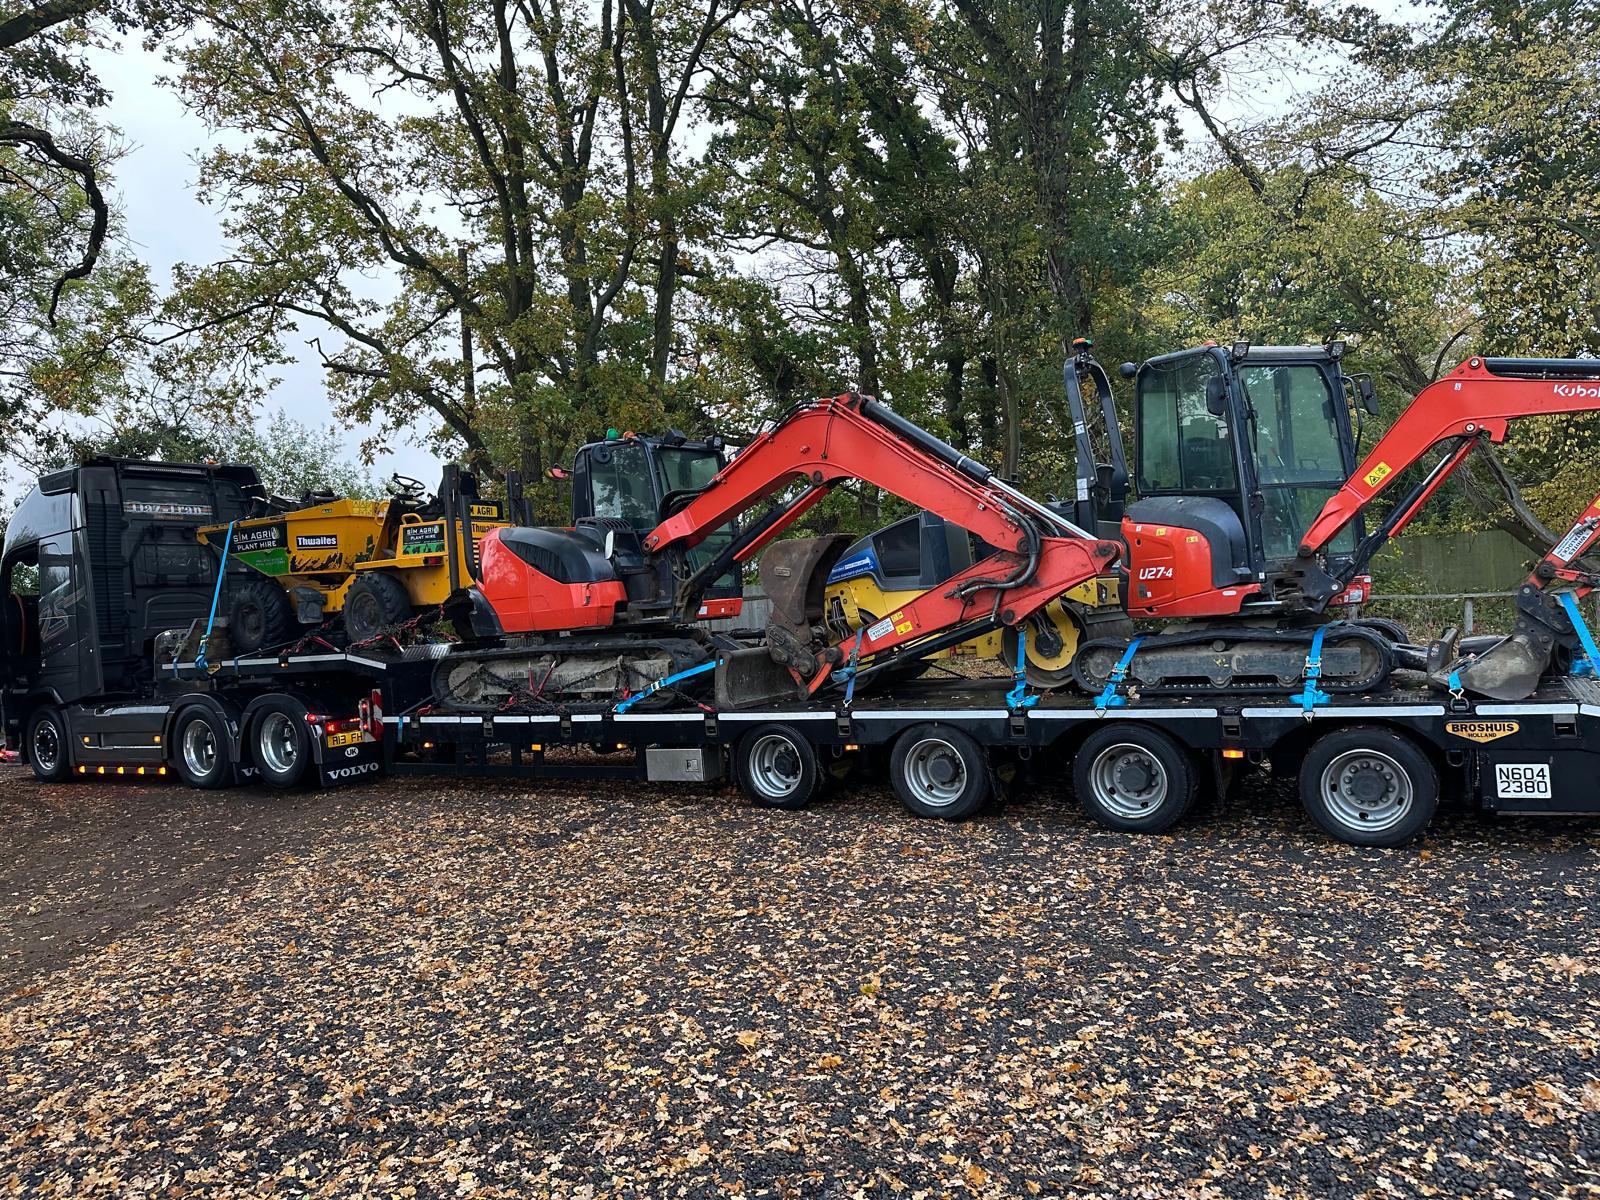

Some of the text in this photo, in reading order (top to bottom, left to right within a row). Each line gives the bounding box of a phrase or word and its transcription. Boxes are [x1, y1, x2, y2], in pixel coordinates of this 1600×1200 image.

[1553, 384, 1600, 398] Kubo
[477, 506, 494, 516] AGRI
[233, 531, 271, 543] SIM AGRI
[297, 536, 337, 546] Thwaites
[237, 541, 277, 552] PLANT HIRE
[1139, 566, 1173, 580] U27-4
[1452, 723, 1515, 732] BROSHUIS
[346, 748, 358, 756] UK
[327, 762, 379, 779] VOLVO
[1499, 767, 1547, 780] N604
[1501, 780, 1548, 793] 2380
